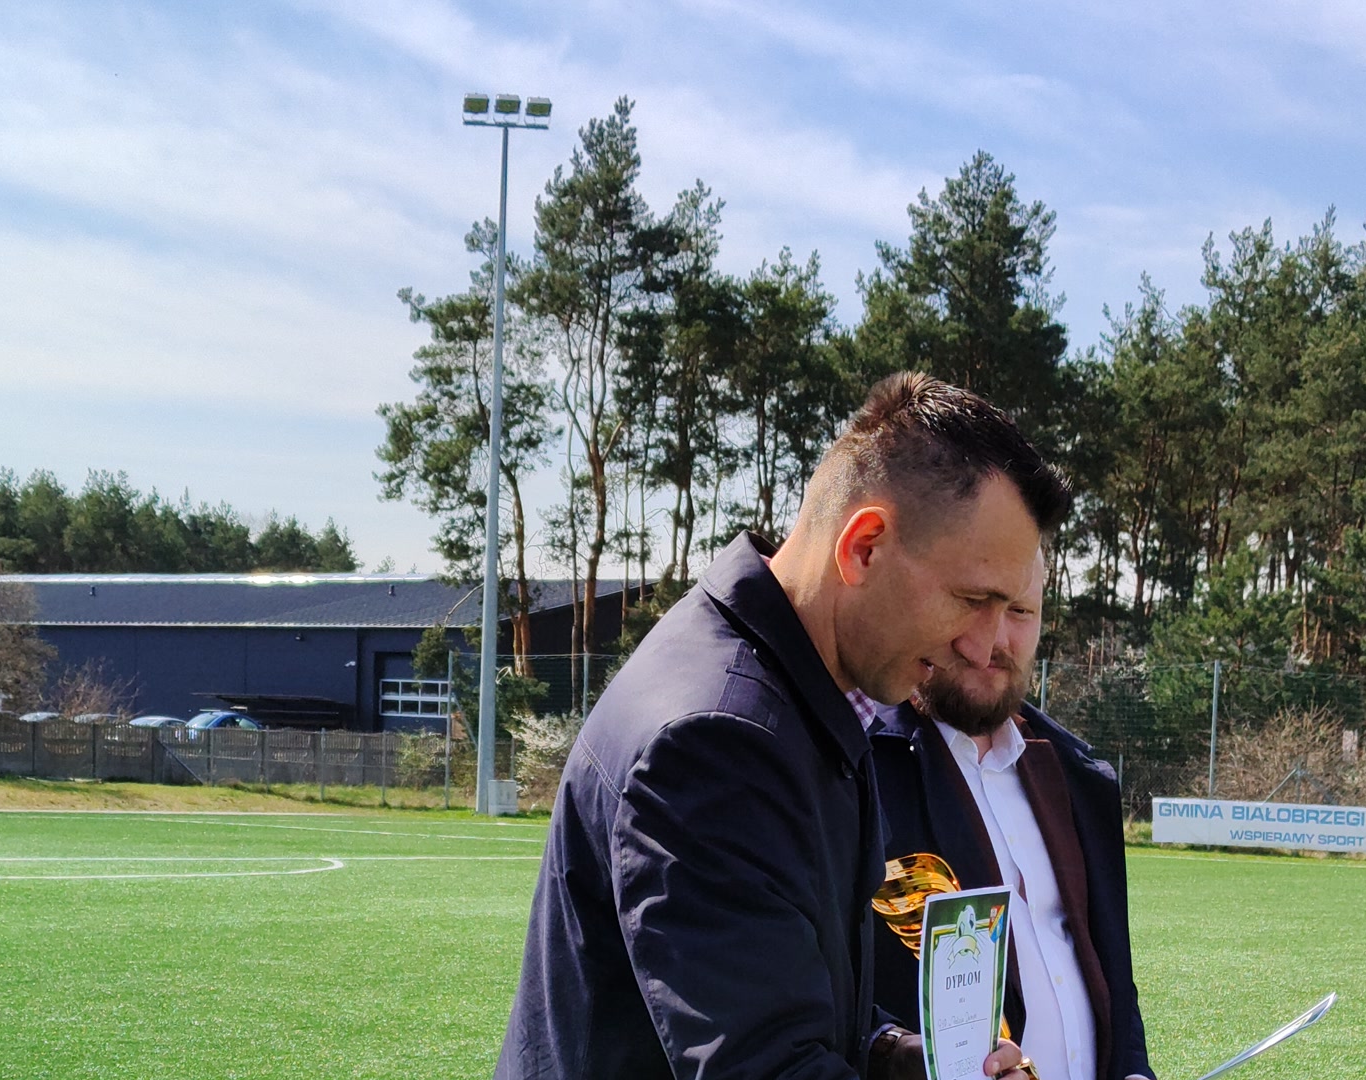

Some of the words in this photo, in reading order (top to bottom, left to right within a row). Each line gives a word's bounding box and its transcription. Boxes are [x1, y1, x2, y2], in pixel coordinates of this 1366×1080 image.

[1159, 803, 1223, 819] GMINA
[1231, 806, 1365, 827] BIAŁOBRZEGI
[1230, 830, 1315, 844] WSPIERAMY
[1318, 834, 1366, 847] SPORT
[945, 970, 981, 991] DYPLOM
